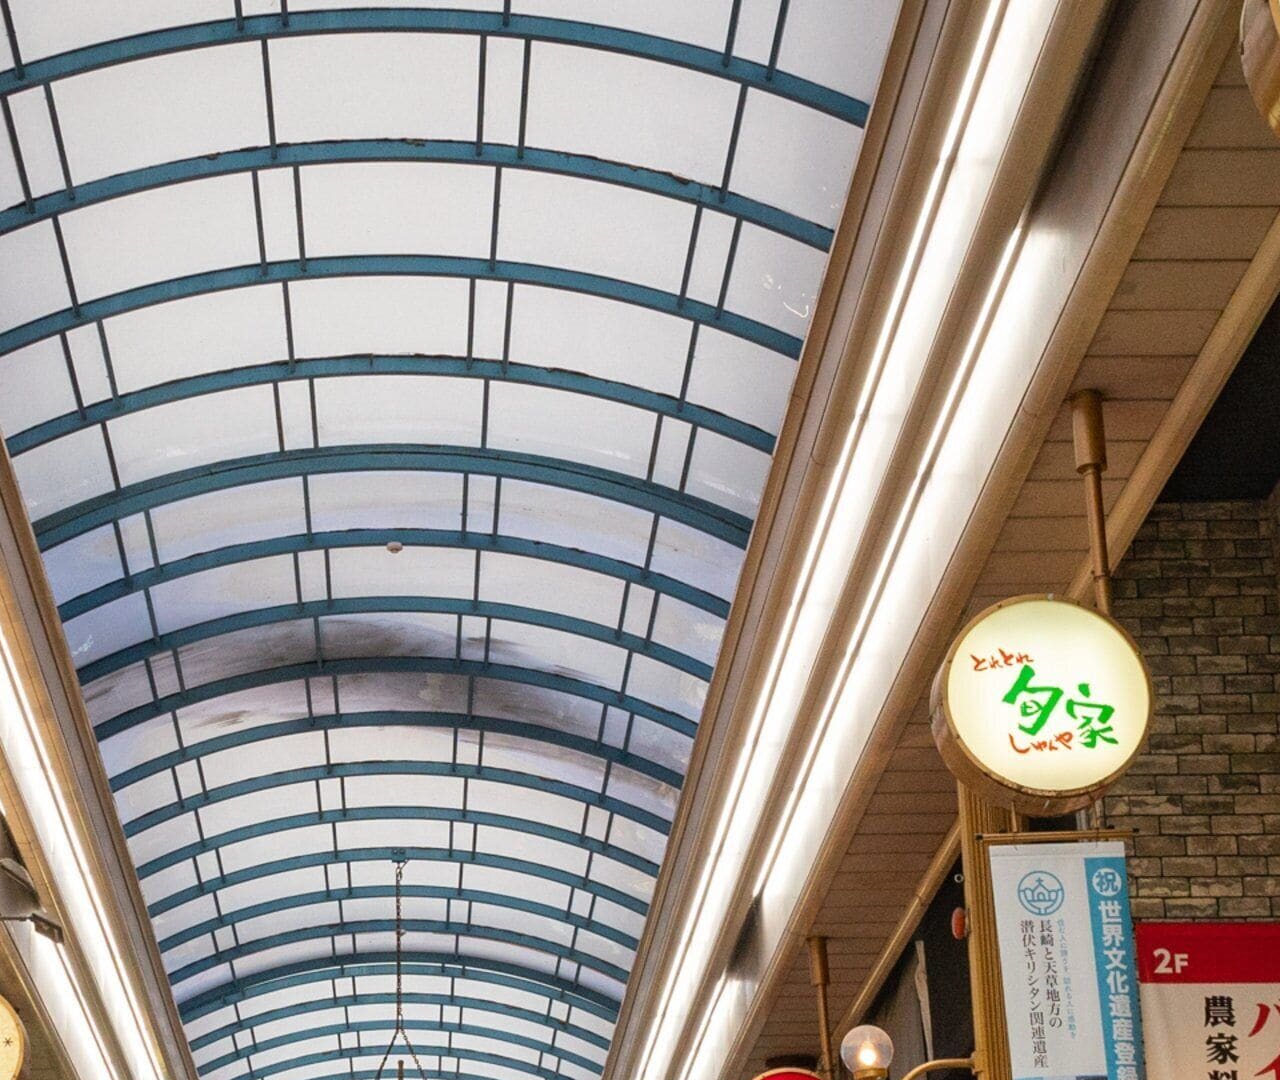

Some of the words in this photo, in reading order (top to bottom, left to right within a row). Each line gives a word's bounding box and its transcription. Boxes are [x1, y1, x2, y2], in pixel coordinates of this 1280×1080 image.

[1001, 664, 1120, 750] 旬家
[1039, 919, 1063, 1029] 長崎と天草地方の
[1153, 947, 1189, 975] 2F
